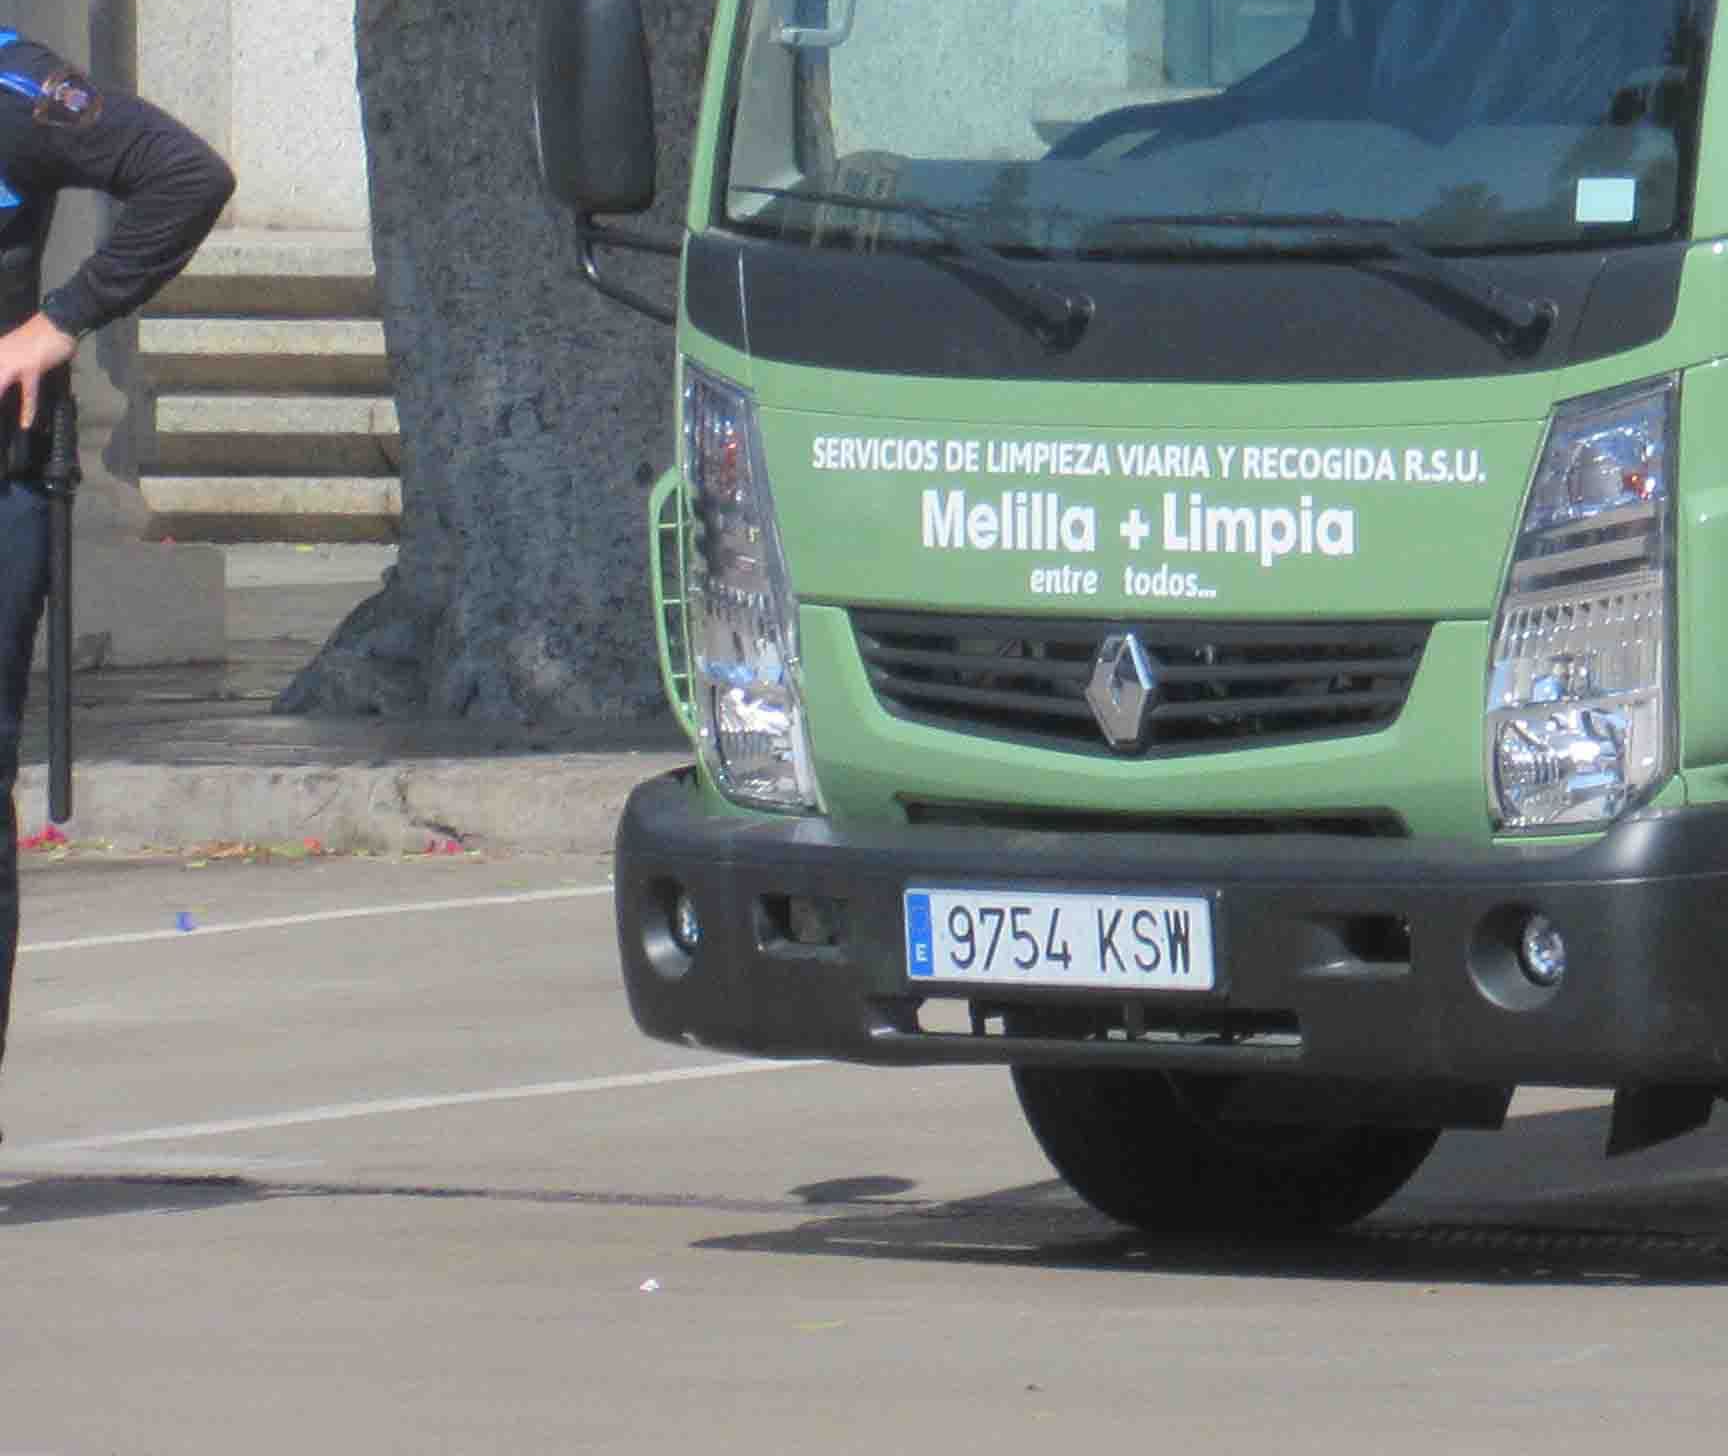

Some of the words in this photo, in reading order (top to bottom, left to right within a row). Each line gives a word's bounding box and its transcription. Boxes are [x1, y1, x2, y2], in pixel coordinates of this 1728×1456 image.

[812, 436, 938, 472] SERVICIOS
[945, 439, 979, 472] DE
[987, 440, 1111, 475] LIMPIEZA
[1117, 442, 1210, 477] VIARIA
[1216, 445, 1236, 478] Y
[1243, 446, 1397, 480] RECOGIDA
[1405, 448, 1487, 482] R.S.U.
[922, 490, 1096, 552] Melilla
[1119, 508, 1150, 550] +
[1162, 493, 1354, 567] Limpia
[1029, 564, 1098, 594] entre
[1123, 562, 1217, 598] todos...
[915, 943, 927, 962] E
[948, 905, 1073, 970] 9754
[1097, 908, 1191, 974] KSW
